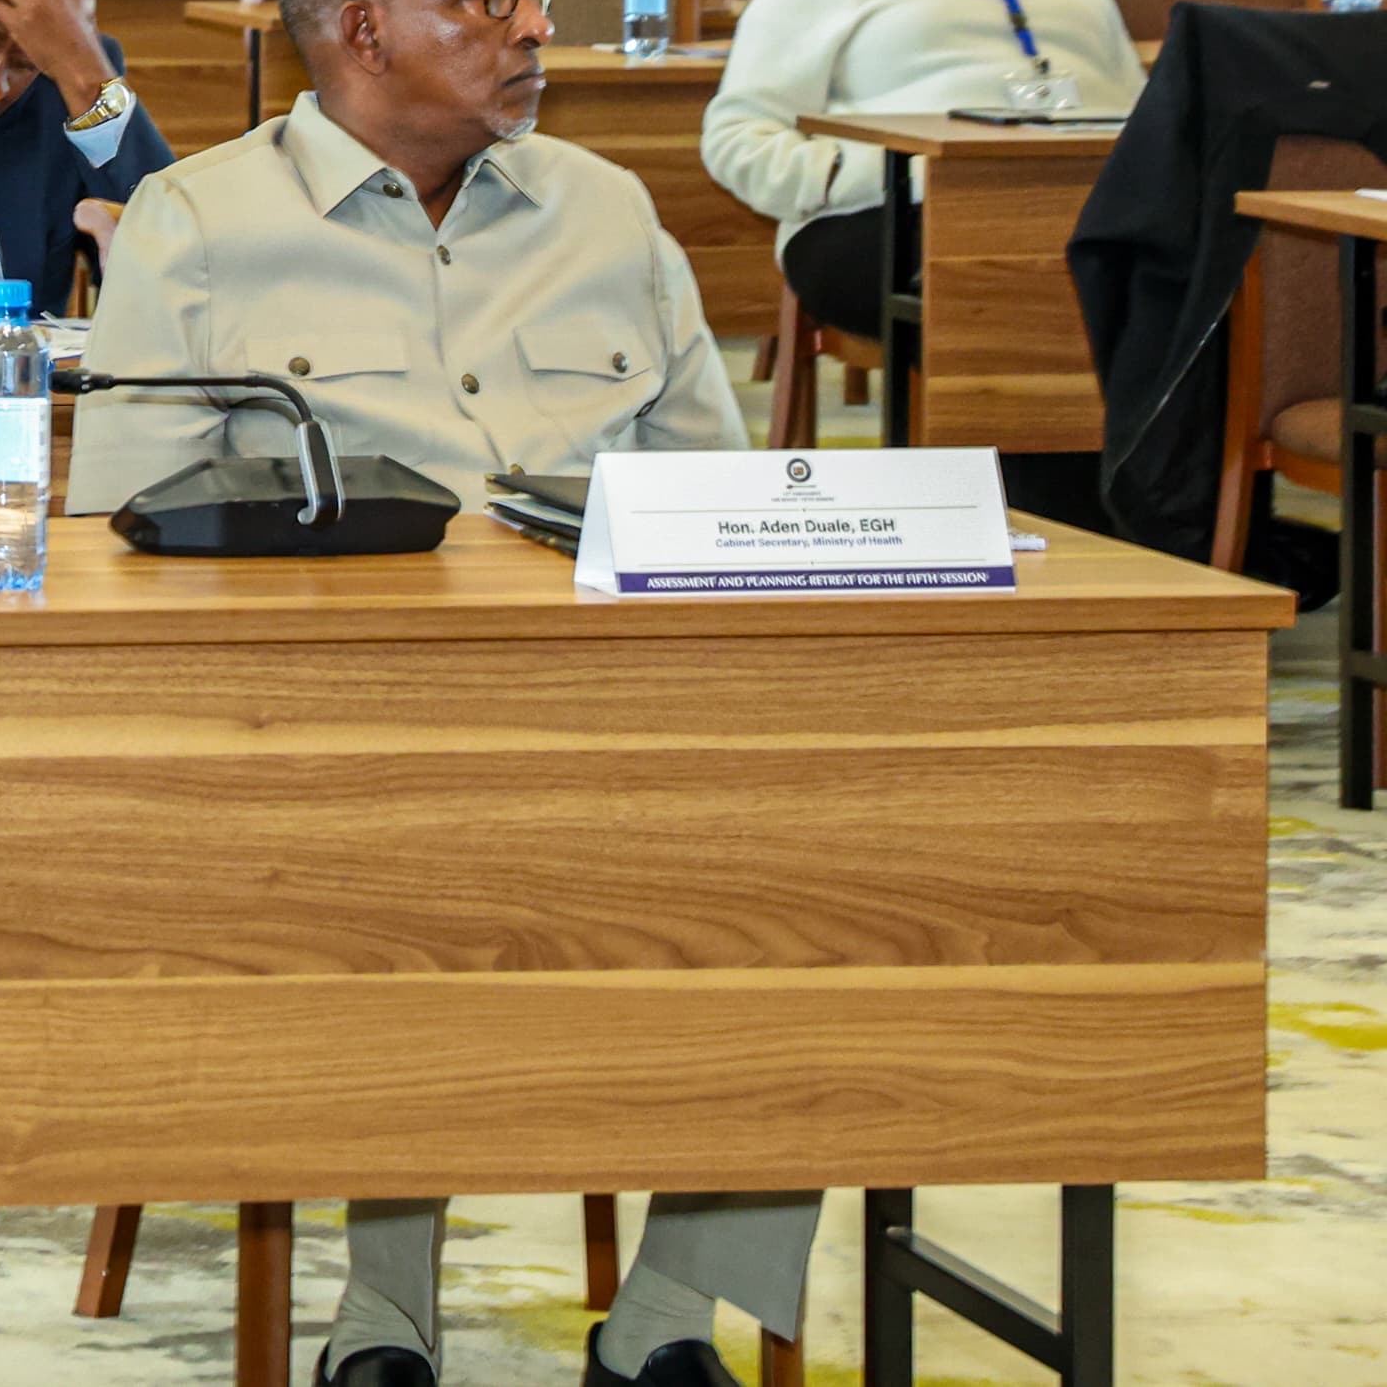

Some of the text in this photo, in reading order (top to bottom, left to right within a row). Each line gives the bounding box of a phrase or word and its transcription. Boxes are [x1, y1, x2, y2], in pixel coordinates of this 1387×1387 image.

[718, 518, 895, 534] Hon. Aden Duale, EGH
[715, 535, 903, 549] Cabinet Secretary, Ministry of Health
[647, 571, 987, 589] ASSESSMENT AND PLANNING RETREAT FOR THE FIFTH SESSION
